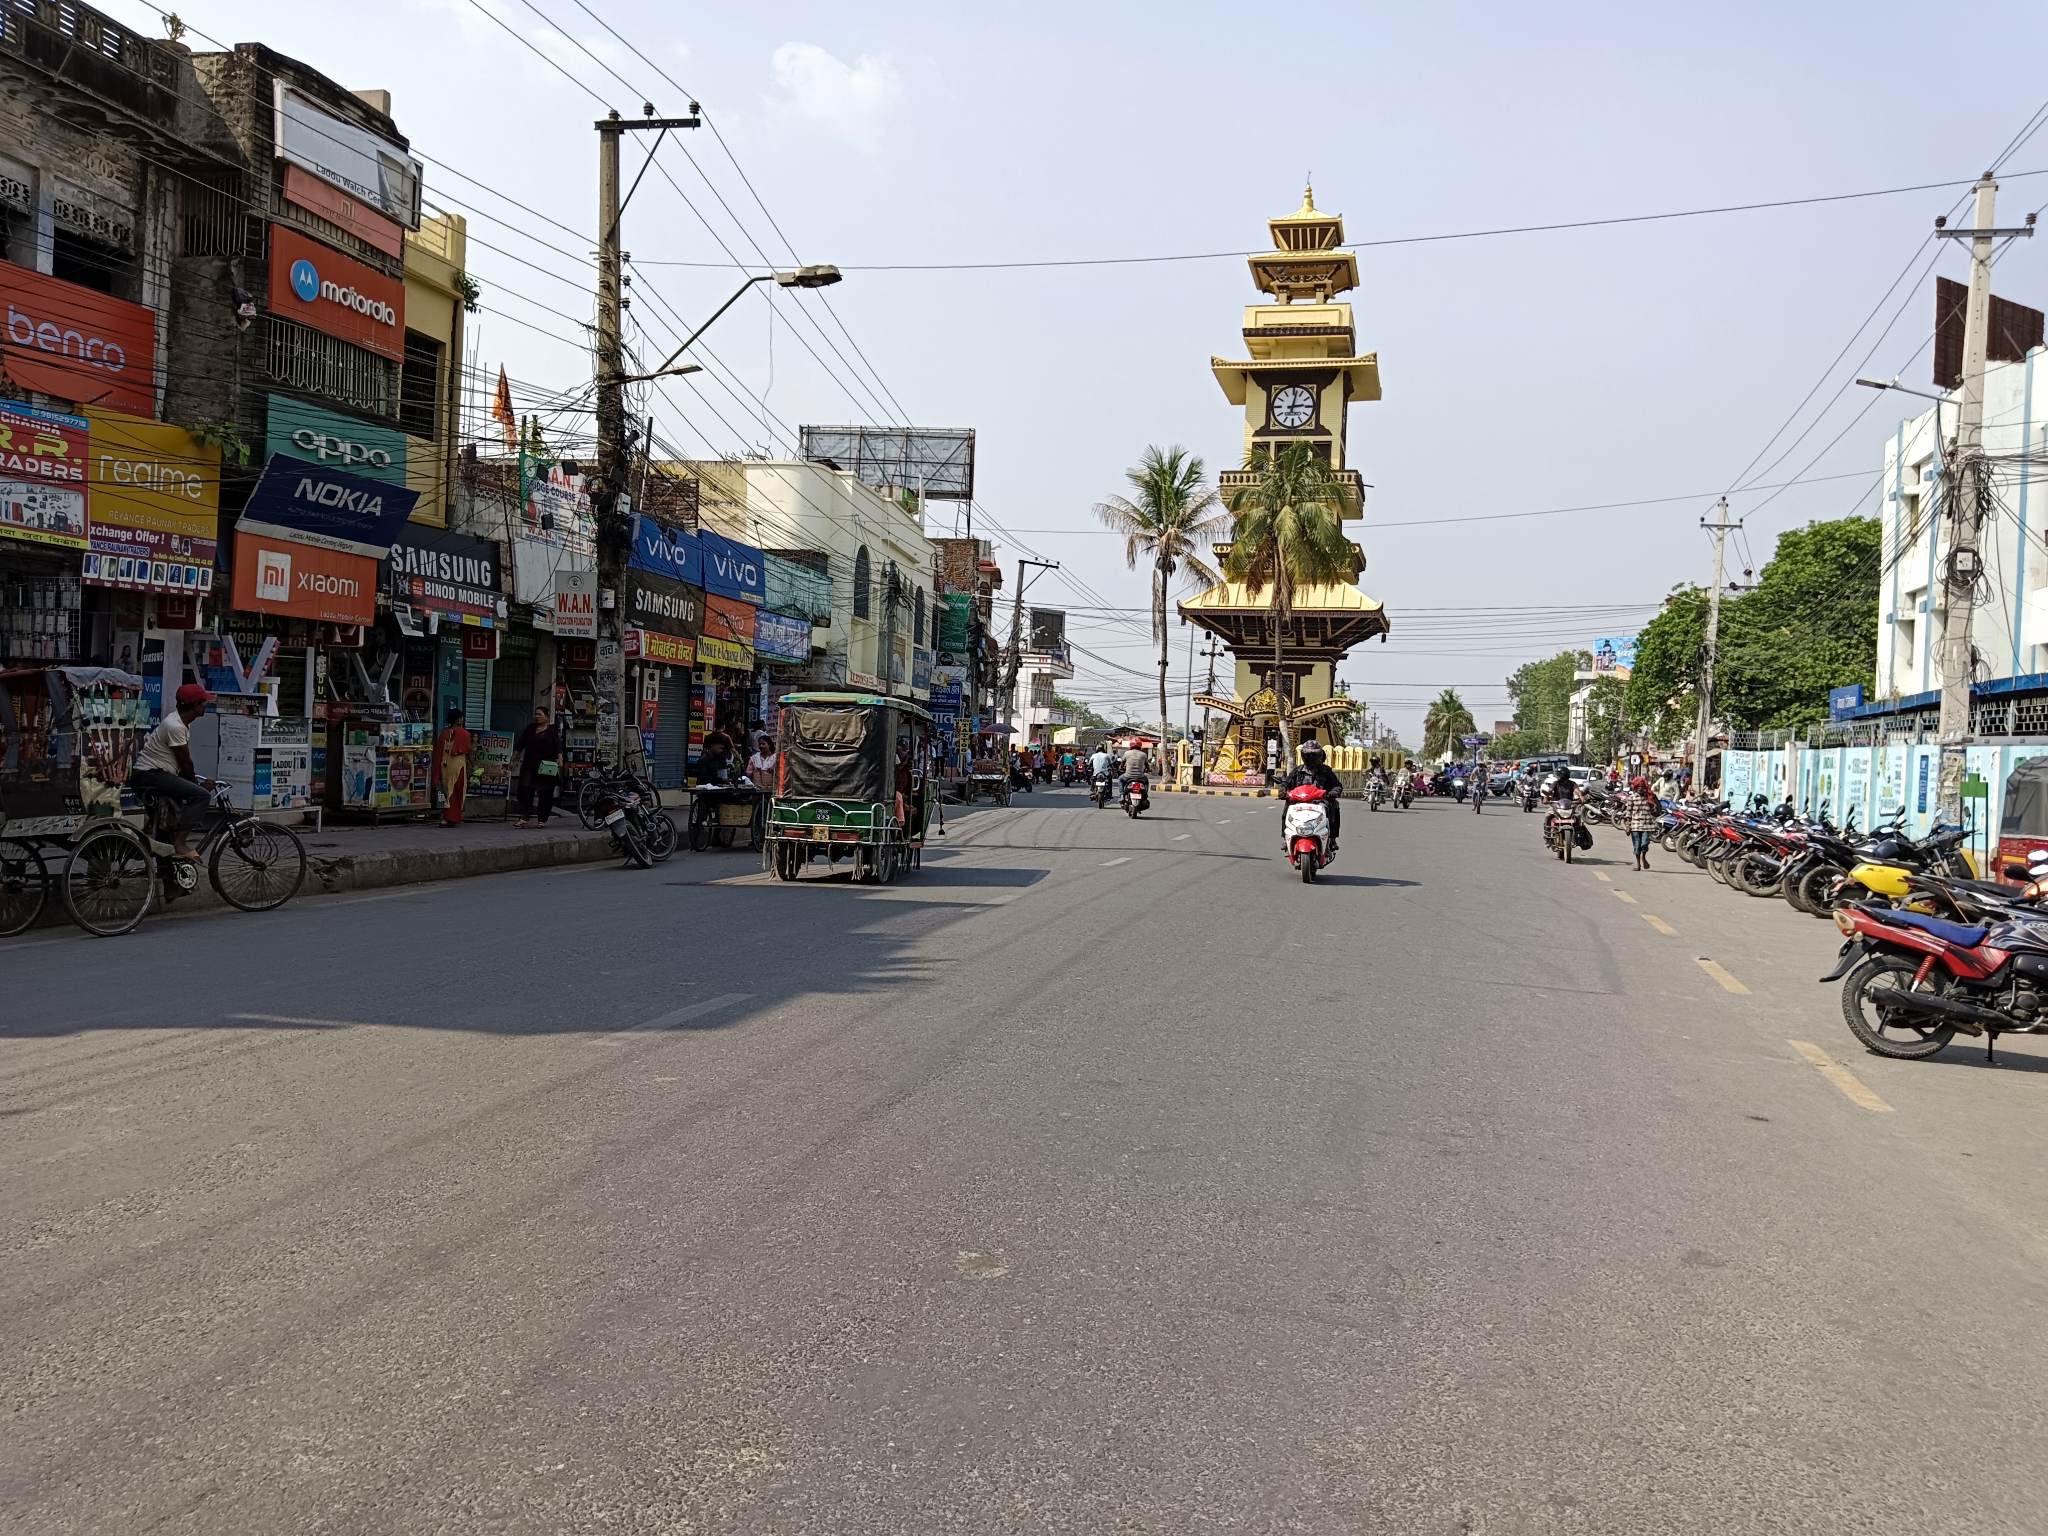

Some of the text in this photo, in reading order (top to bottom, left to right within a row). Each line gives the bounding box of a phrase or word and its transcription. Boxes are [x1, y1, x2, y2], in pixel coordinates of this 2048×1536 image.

[320, 279, 396, 327] motorola
[7, 303, 126, 373] benco
[291, 428, 392, 469] oppo
[99, 454, 203, 499] realme
[294, 477, 384, 518] NOKIA
[135, 529, 160, 544] Offer
[645, 533, 686, 566] vivo
[390, 543, 492, 587] SAMSUNG
[713, 550, 757, 587] vivo
[297, 571, 359, 598] xiaomi
[424, 581, 494, 608] BINOD MOBILE
[558, 593, 594, 615] W.A.N.
[635, 588, 695, 622] SAMSUNG
[229, 632, 262, 644] MOBIL
[144, 683, 161, 693] vivo
[272, 760, 293, 770] LADDU
[272, 770, 292, 778] MOBILE
[254, 783, 272, 791] vivo
